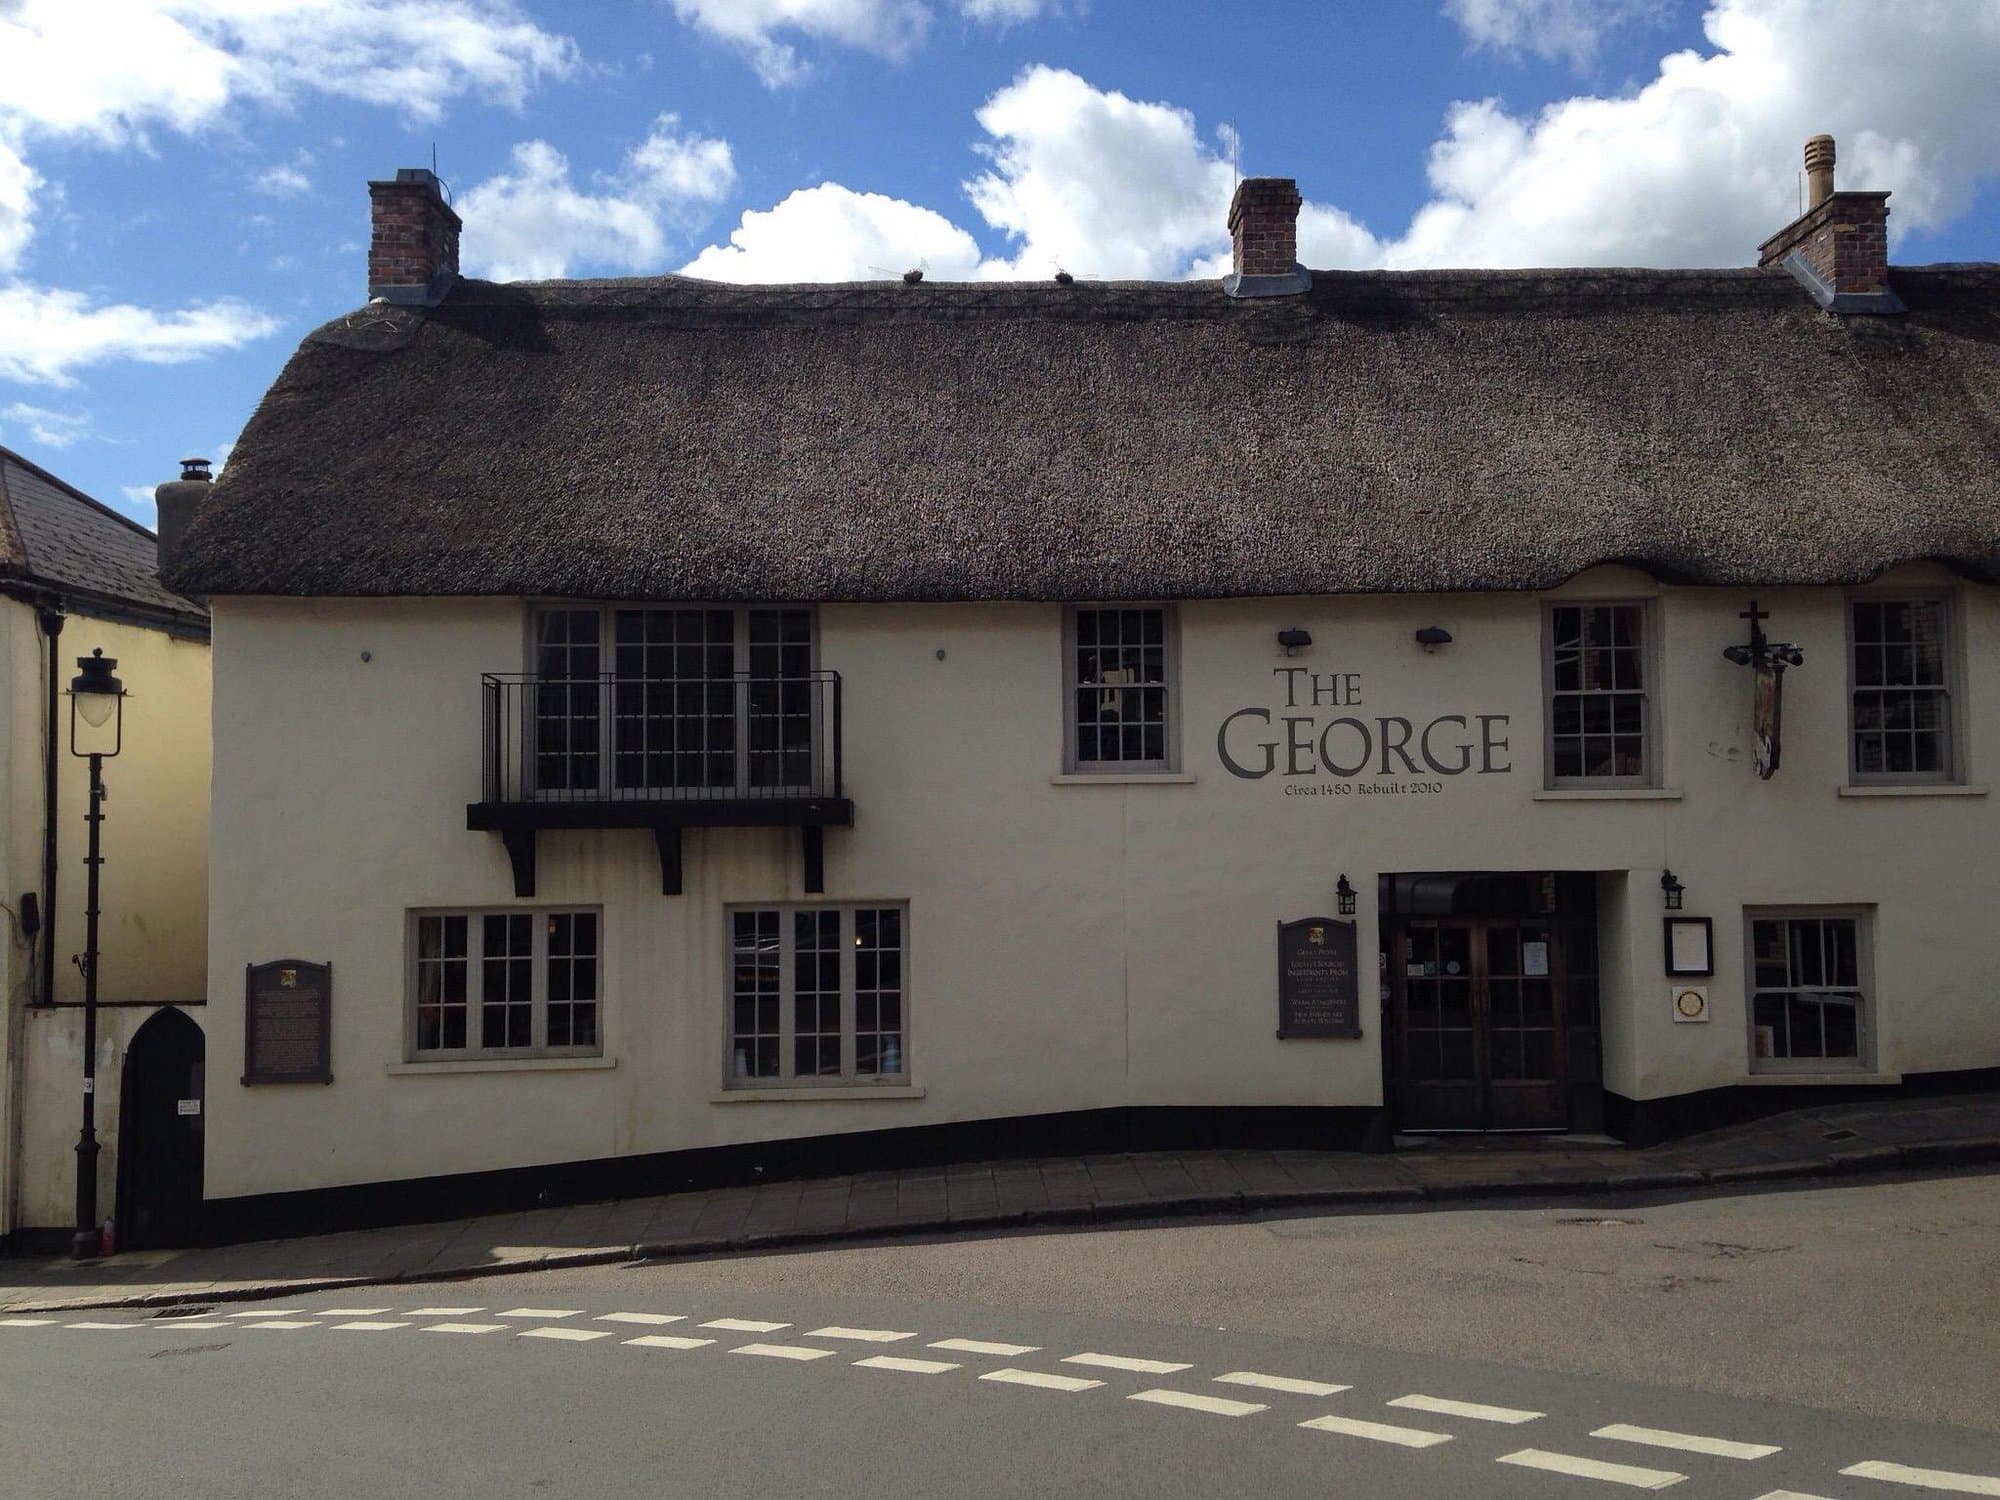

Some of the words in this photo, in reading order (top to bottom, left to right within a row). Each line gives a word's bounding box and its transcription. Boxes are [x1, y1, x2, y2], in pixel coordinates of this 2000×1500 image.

[1273, 667, 1362, 707] THE
[1217, 707, 1512, 779] GEORGE
[1284, 783, 1317, 796] Circa
[1321, 782, 1352, 796] 1450
[1358, 782, 1406, 796] Rebuilt
[1410, 781, 1443, 795] 2010
